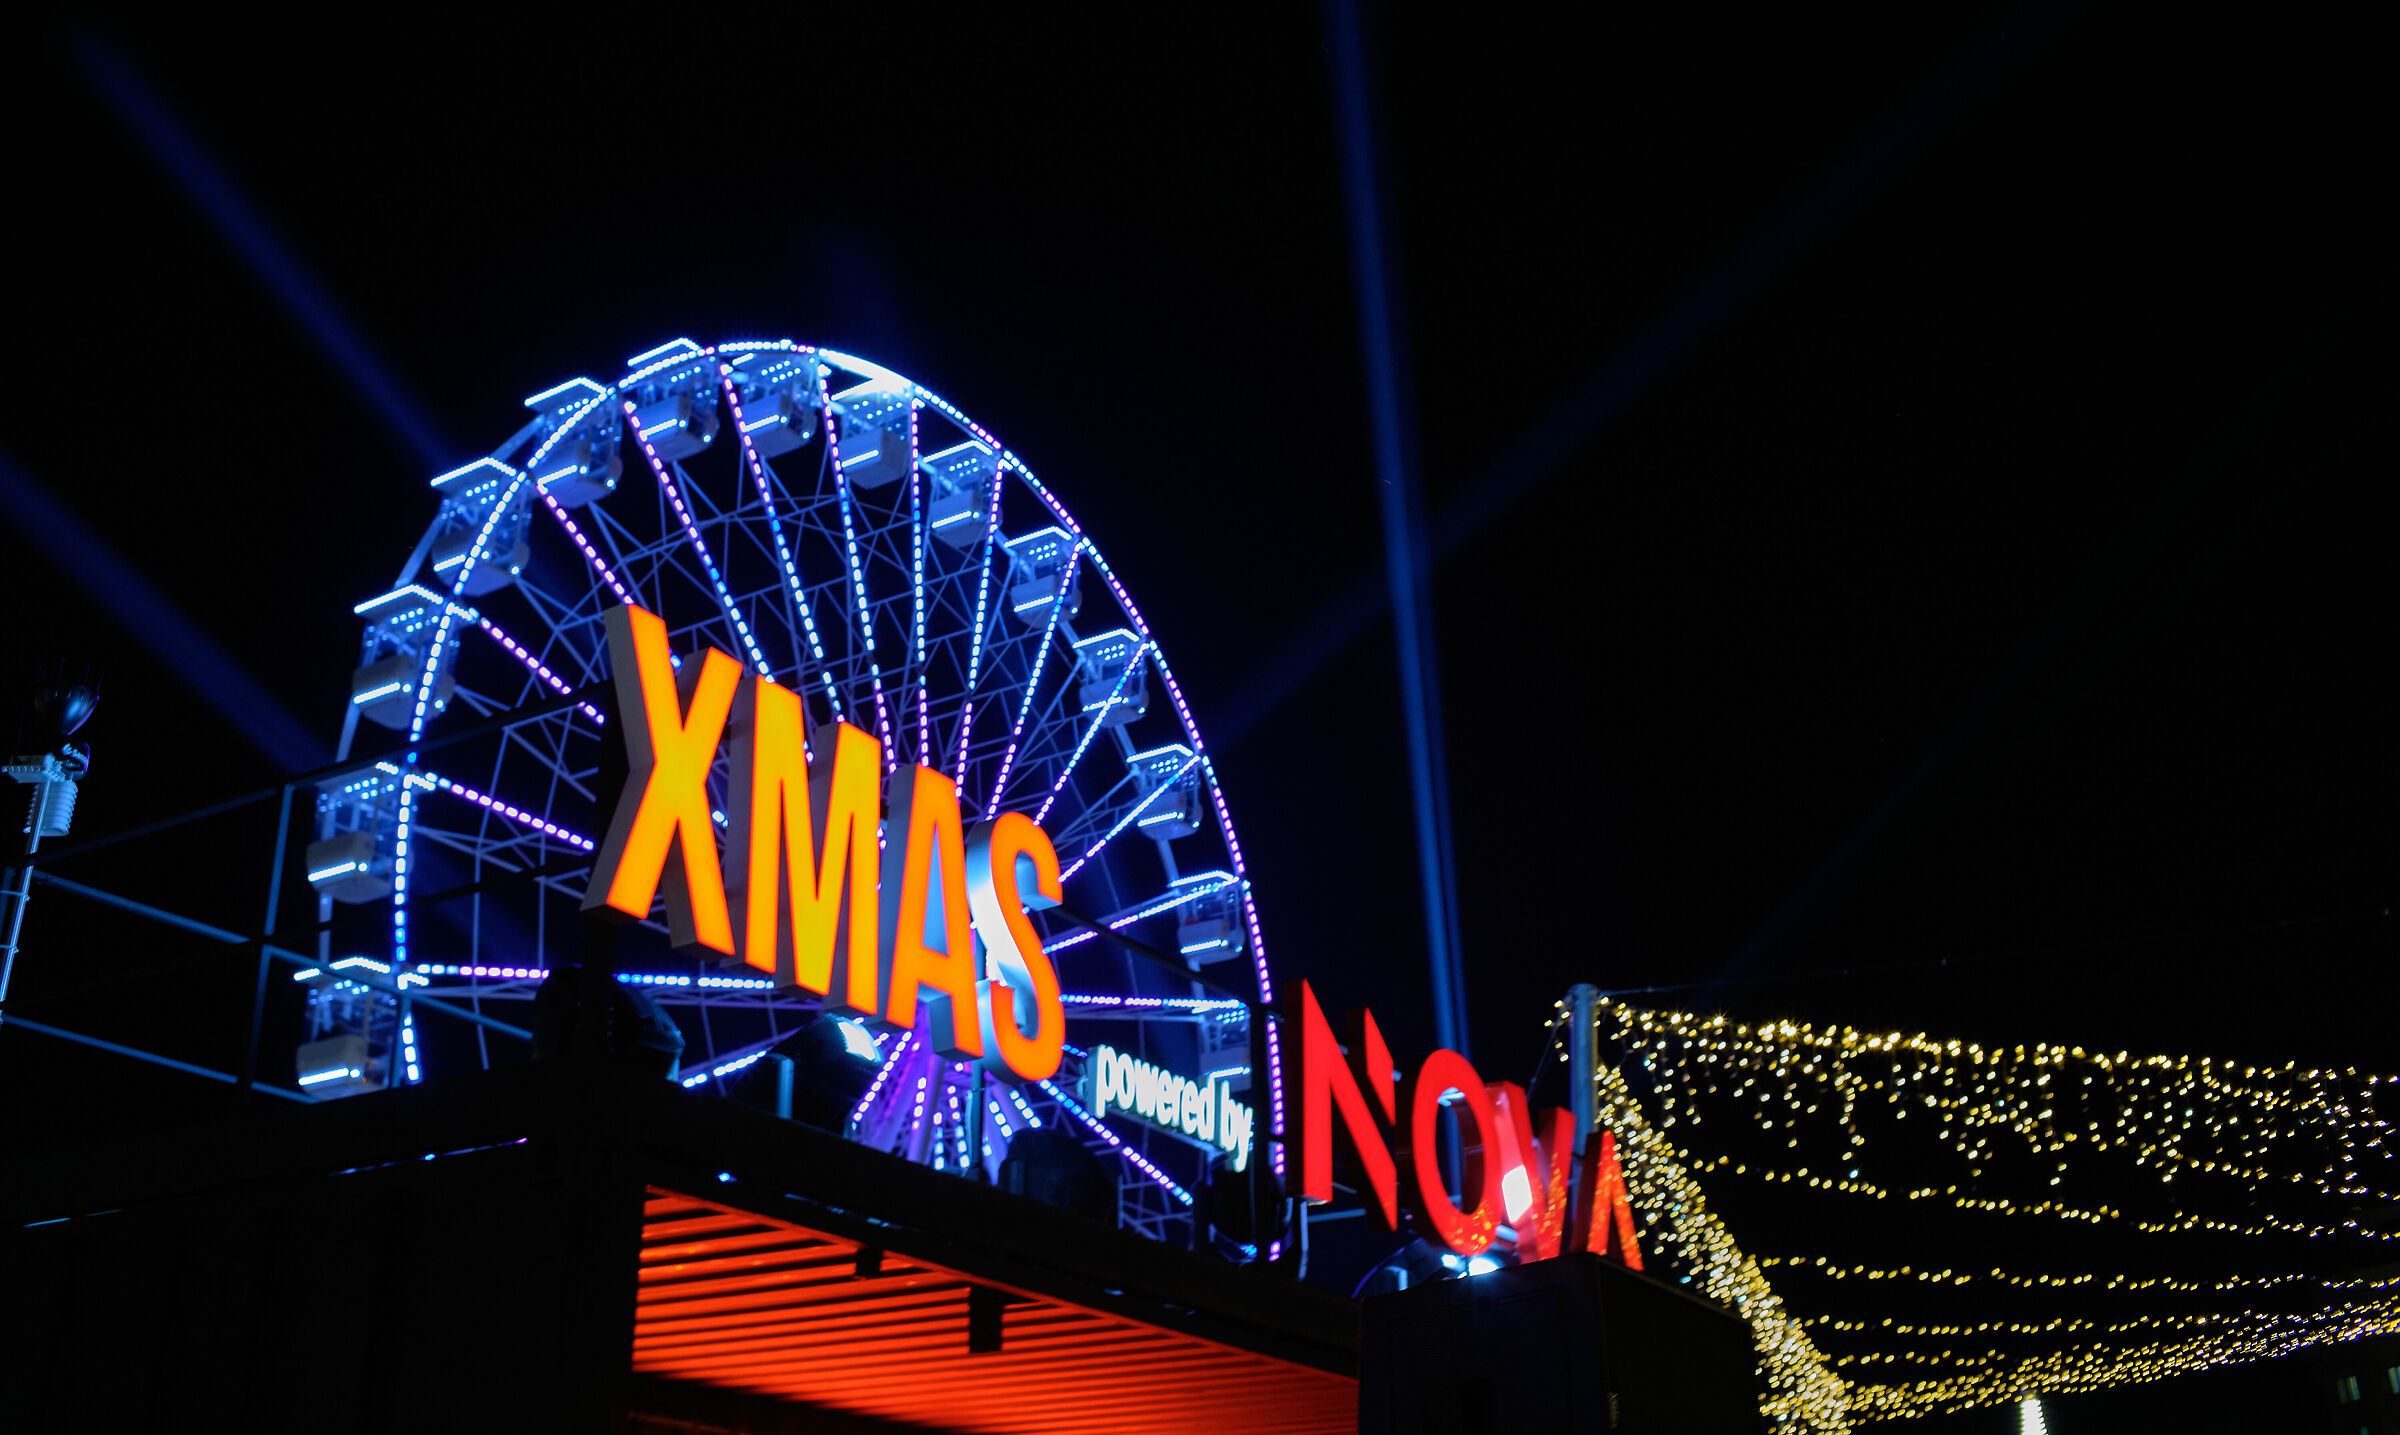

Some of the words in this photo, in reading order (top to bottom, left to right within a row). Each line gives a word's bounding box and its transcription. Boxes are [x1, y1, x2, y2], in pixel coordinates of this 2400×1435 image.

[605, 602, 1066, 1082] XMAS
[1095, 1044, 1216, 1140] powered
[1219, 1080, 1253, 1172] by
[1302, 977, 1644, 1272] NOVA
